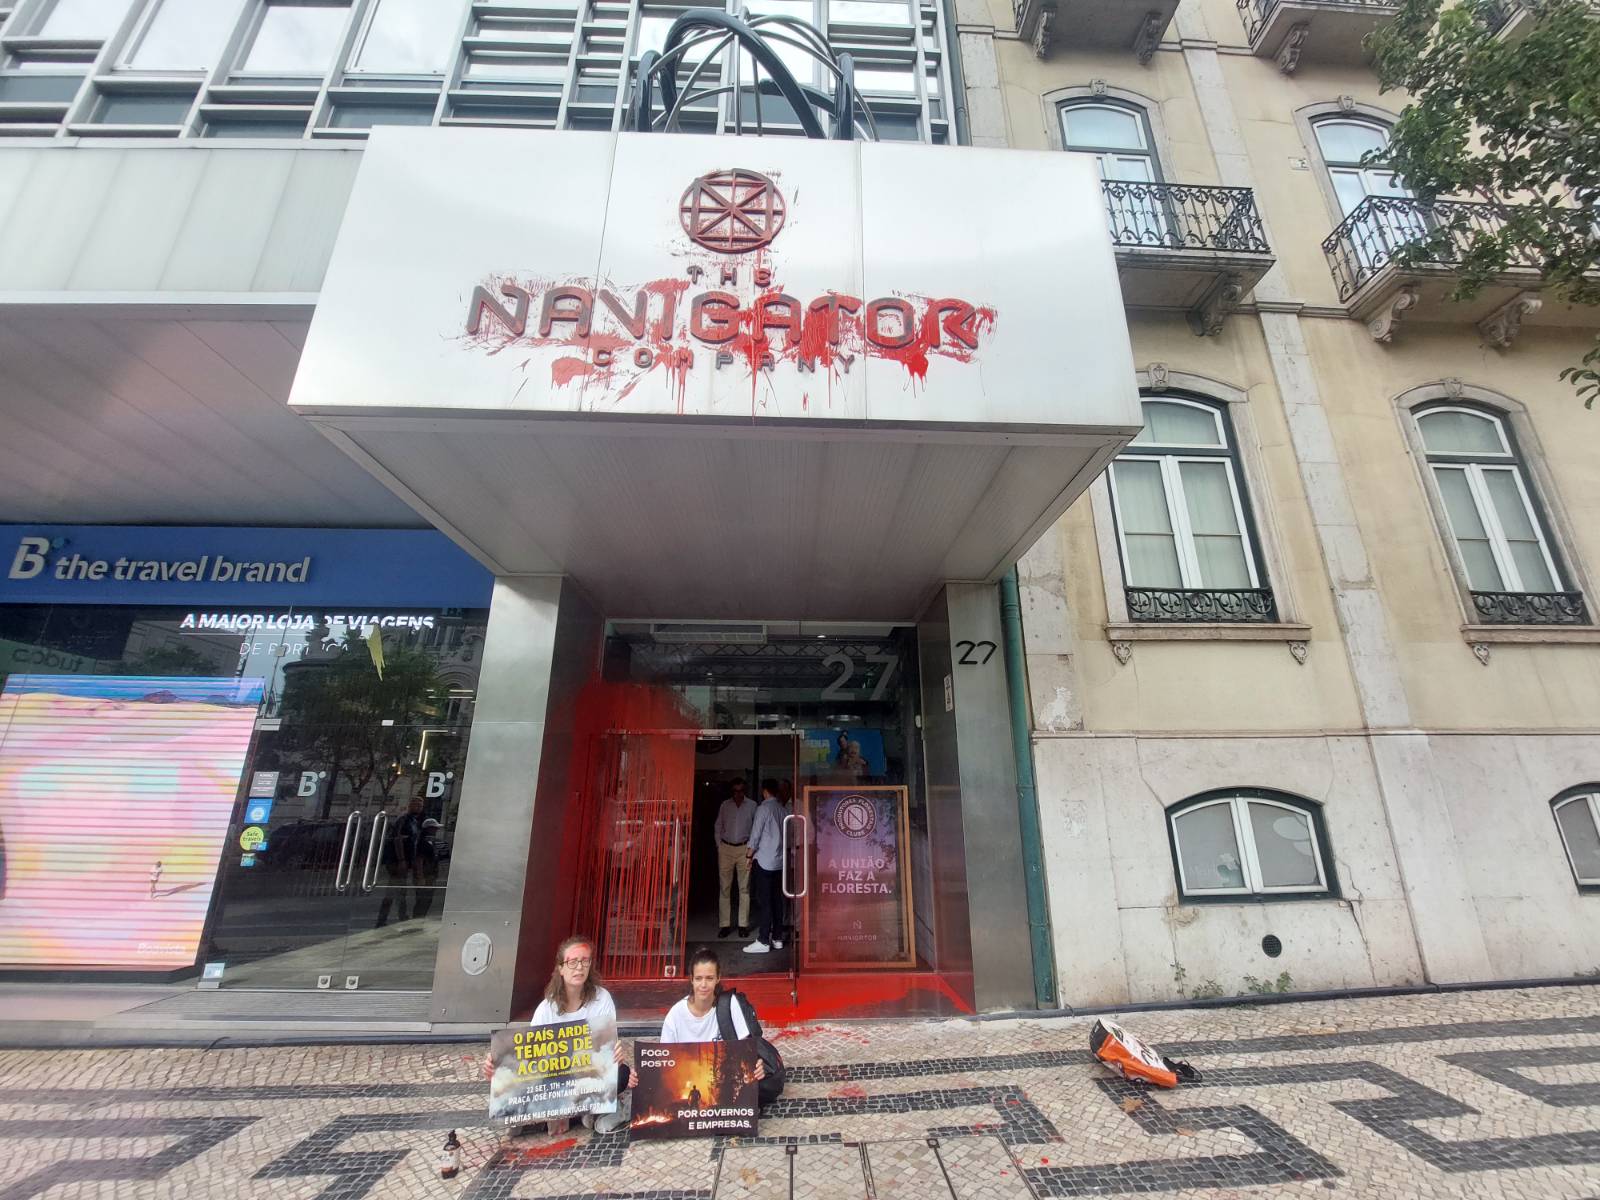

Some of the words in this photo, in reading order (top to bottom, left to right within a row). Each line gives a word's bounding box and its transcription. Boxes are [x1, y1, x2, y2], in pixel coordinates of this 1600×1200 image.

[687, 265, 771, 287] THE
[466, 284, 979, 349] NAVIGATOR
[593, 347, 856, 373] COMPANY
[8, 536, 49, 579] B
[54, 554, 108, 581] the
[114, 555, 208, 582] travel
[210, 555, 312, 583] brand
[180, 614, 194, 629] A
[198, 614, 263, 629] MAIOR
[267, 614, 315, 630] LOJA
[348, 615, 434, 631] VIAGENS
[240, 642, 262, 655] DE
[955, 640, 998, 665] 27
[821, 653, 898, 701] 27
[297, 771, 319, 797] B
[426, 772, 446, 798] B
[828, 860, 838, 869] A
[841, 856, 885, 869] UNIÃO
[838, 870, 863, 881] FAZ
[867, 870, 875, 881] A
[822, 883, 892, 894] FLORESTA.
[513, 1033, 523, 1045] O
[526, 1027, 554, 1043] PAÍS
[558, 1024, 593, 1039] ARDE.
[514, 1040, 568, 1060] TEMOS
[573, 1036, 593, 1051] DE
[641, 1049, 669, 1057] FOGO
[518, 1052, 592, 1075] ACORDAR
[508, 1093, 530, 1105] PRAÇA
[526, 1086, 535, 1094] 22
[504, 1116, 509, 1124] E
[509, 1113, 531, 1123] MUITAS
[532, 1111, 546, 1119] MAIS
[678, 1110, 698, 1118] POR
[700, 1108, 754, 1117] GOVERNOS
[688, 1122, 694, 1130] E
[696, 1120, 752, 1130] EMPRESAS.
